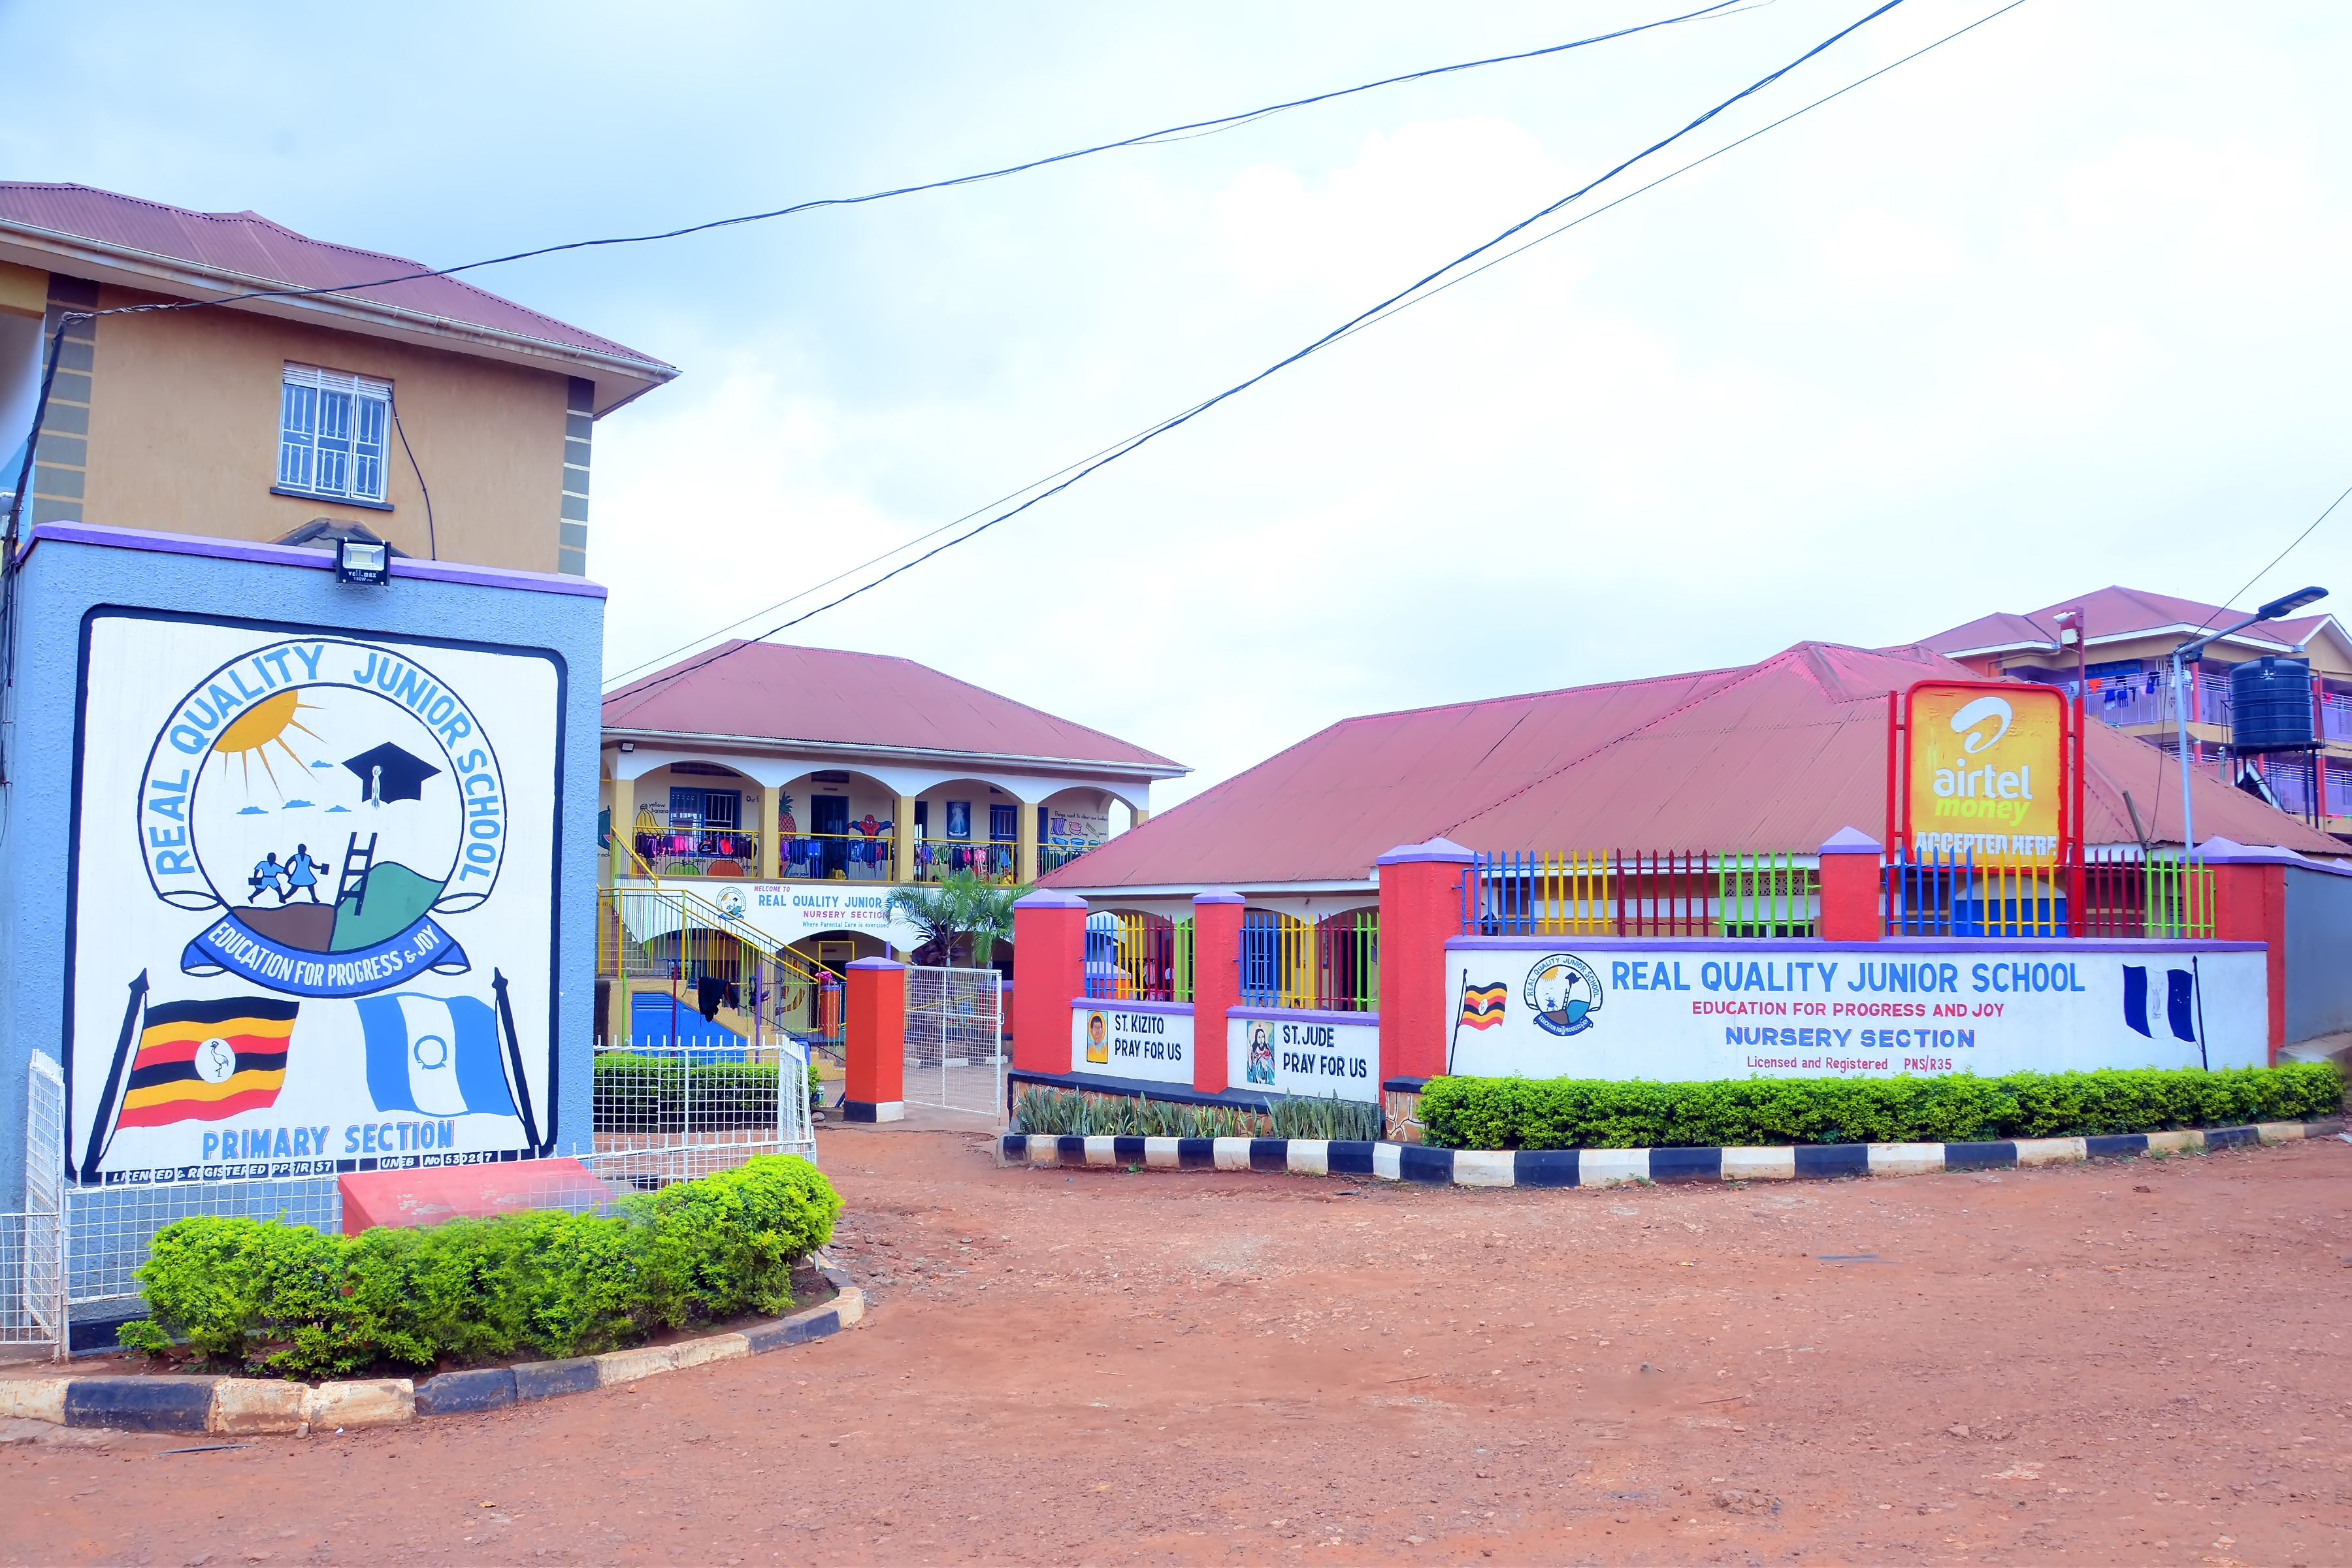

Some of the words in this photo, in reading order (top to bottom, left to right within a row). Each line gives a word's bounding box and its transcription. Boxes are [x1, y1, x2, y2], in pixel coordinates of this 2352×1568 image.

[170, 644, 324, 755] QUALITY
[353, 652, 471, 750] JUNIOR
[1933, 758, 2033, 800] airtel
[148, 768, 196, 875] REAL
[457, 748, 500, 881] SCHOOL
[1935, 798, 2031, 826] money
[1915, 832, 2008, 854] ACCEPTED
[2012, 835, 2057, 856] HERE
[759, 894, 787, 907] REAL
[792, 895, 839, 907] QUALITY
[845, 896, 882, 908] JUNIOR
[208, 921, 295, 981] EDUCATION
[294, 960, 323, 986] FOR
[327, 950, 404, 987] PROGRESS
[404, 949, 417, 964] &
[412, 924, 440, 956] JOY
[1527, 977, 1535, 996] REAL
[1533, 958, 1560, 975] QUALITY
[1563, 957, 1586, 973] JUNIOR
[1585, 971, 1599, 998] SCHOOL
[1612, 961, 1691, 990] REAL
[1701, 962, 1838, 992] QUALITY
[1848, 962, 1958, 992] JUNIOR
[1972, 962, 2085, 992] SCHOOL
[1692, 1001, 1787, 1015] EDUCATION
[1793, 1002, 1827, 1016] FOR
[1833, 1003, 1925, 1017] PROGRESS
[1933, 1004, 1967, 1017] AND
[1972, 1004, 2004, 1017] JOY
[1115, 1014, 1128, 1032] ST.
[1131, 1014, 1164, 1034] KIZITO
[1726, 1026, 1852, 1047] NURSERY
[1860, 1029, 1975, 1048] SECTION
[1115, 1037, 1141, 1057] PRAY
[1145, 1041, 1164, 1060] FOR
[1168, 1042, 1181, 1061] US
[1283, 1053, 1316, 1073] PRAY
[1320, 1054, 1345, 1077] FOR
[1349, 1057, 1367, 1078] US
[1748, 1056, 1797, 1068] Licensed
[1802, 1056, 1821, 1069] and
[1826, 1056, 1887, 1073] Registered
[1904, 1055, 1952, 1073] PNS/R35
[203, 1126, 329, 1160] PRIMARY
[345, 1120, 455, 1154] SECTION
[188, 1165, 266, 1178] REGISTERED
[382, 1157, 414, 1168] UNEB
